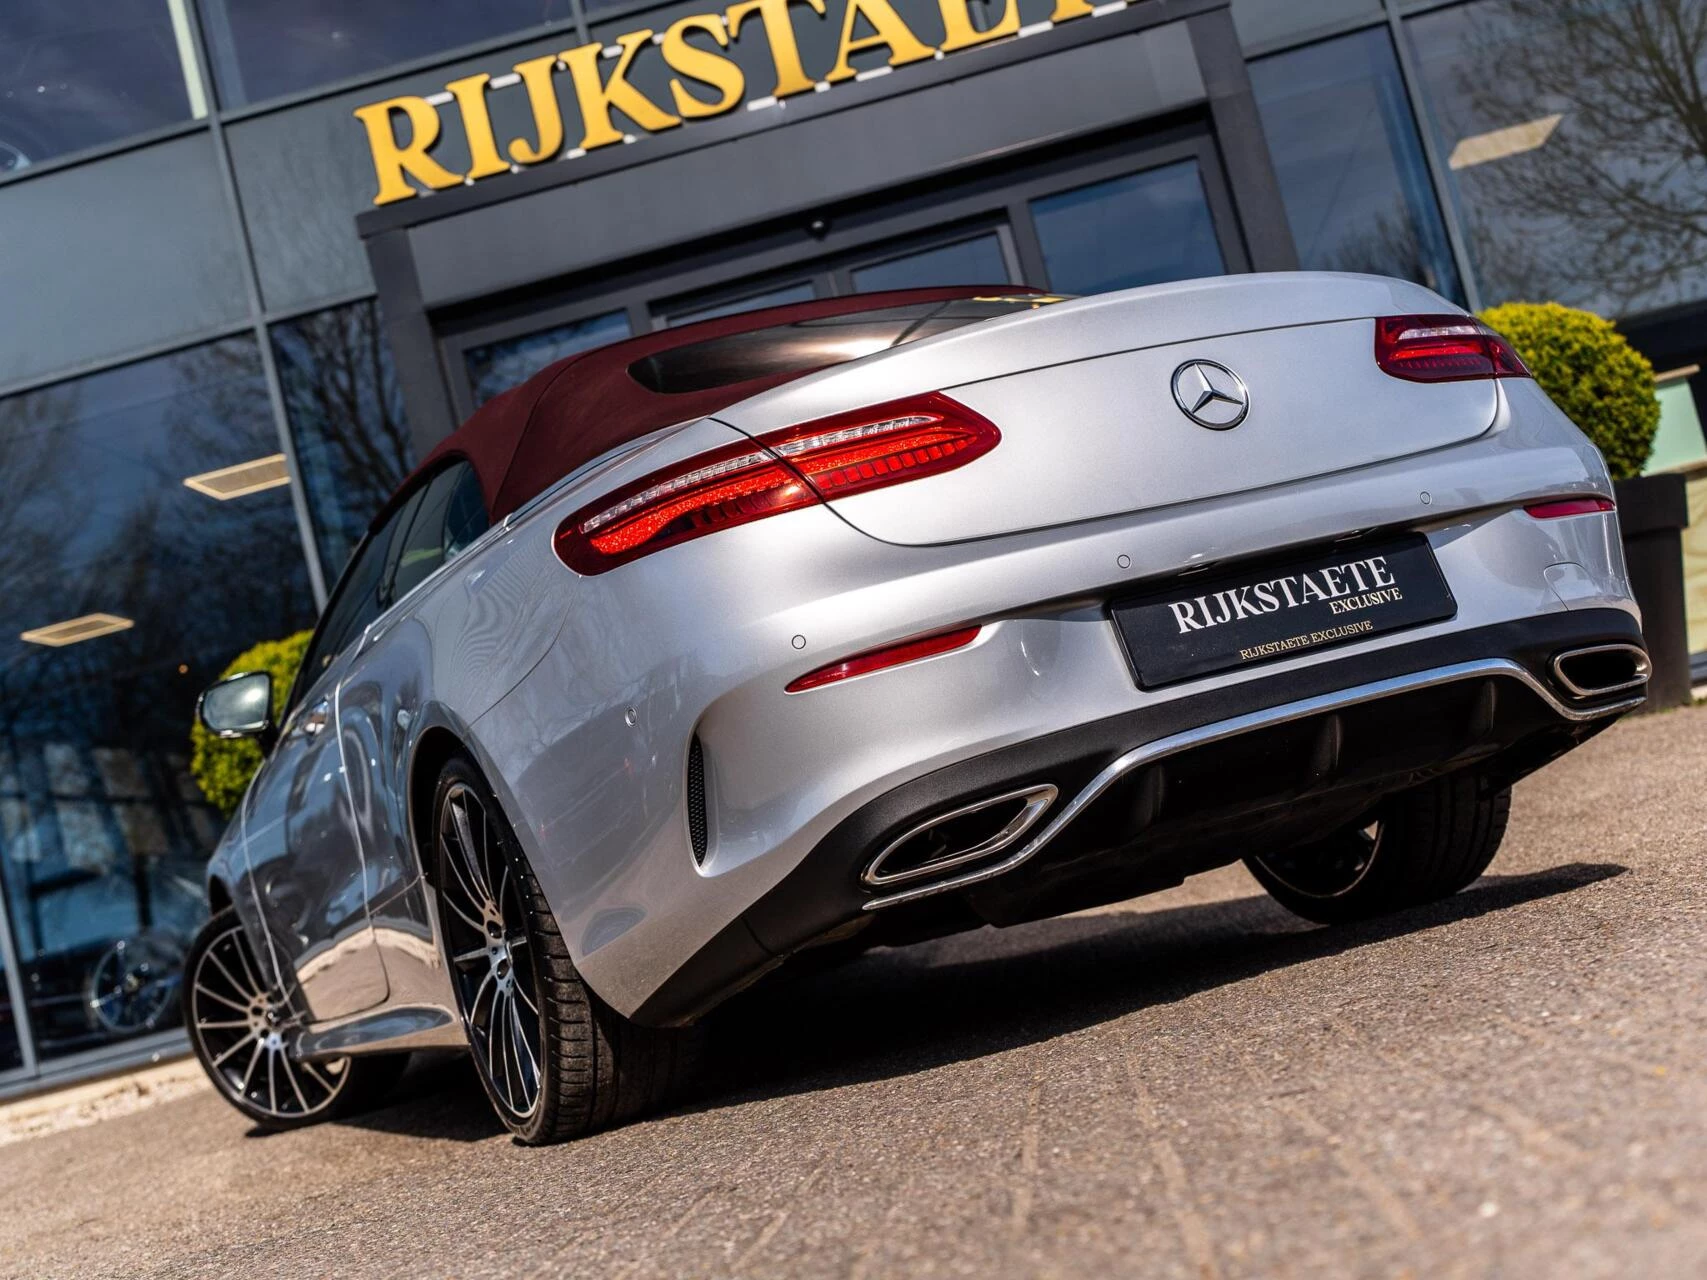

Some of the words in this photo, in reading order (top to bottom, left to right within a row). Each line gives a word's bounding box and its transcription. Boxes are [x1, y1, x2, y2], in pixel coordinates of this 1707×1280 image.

[354, 0, 1097, 205] RIJKSTA
[1168, 556, 1396, 634] RIJKSTAETE
[1329, 587, 1403, 615] EXCLUSIVE
[1239, 635, 1310, 661] RIJKSTAETE
[1311, 620, 1374, 644] EXCLUSIVE
